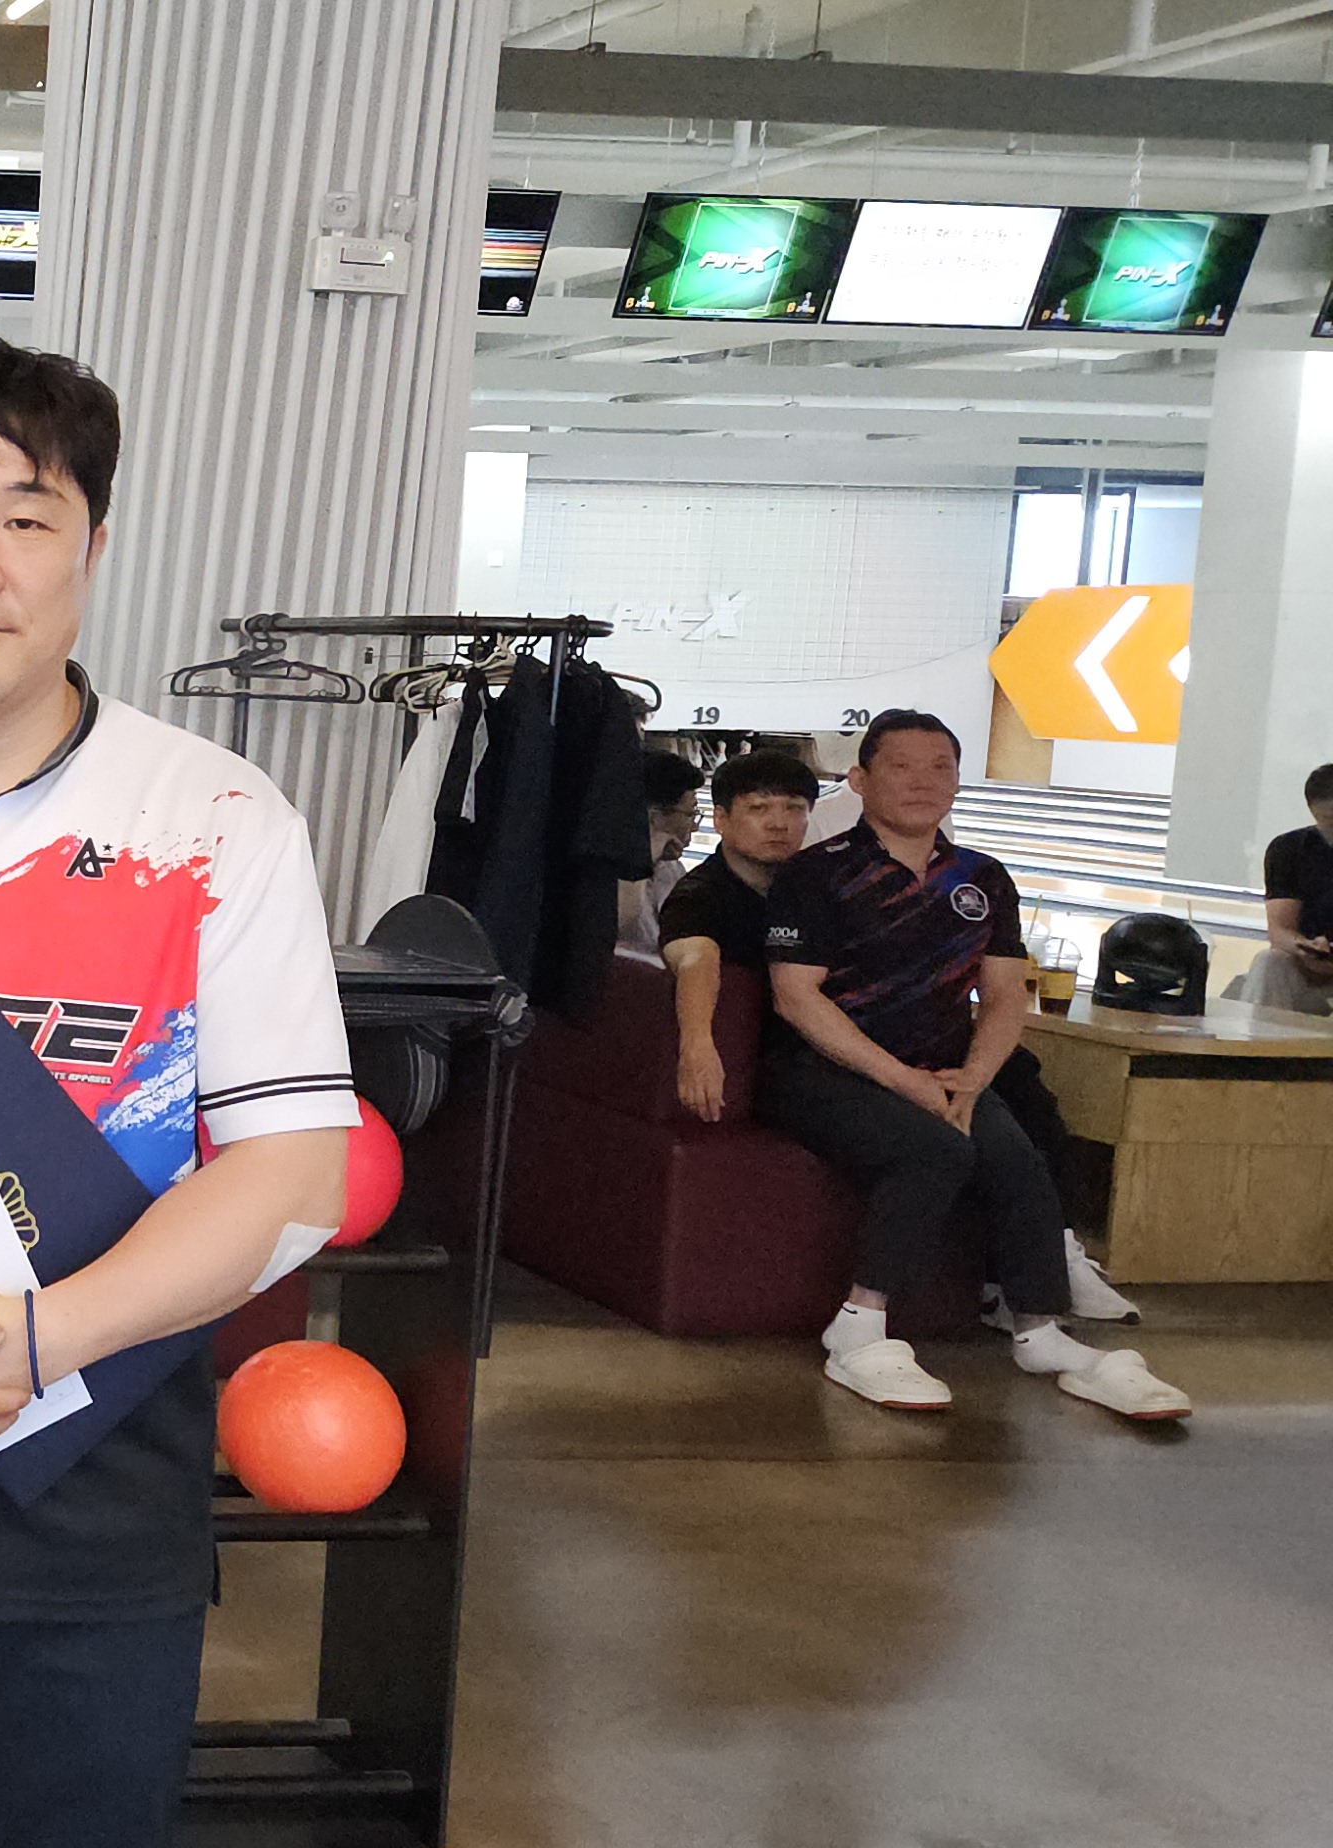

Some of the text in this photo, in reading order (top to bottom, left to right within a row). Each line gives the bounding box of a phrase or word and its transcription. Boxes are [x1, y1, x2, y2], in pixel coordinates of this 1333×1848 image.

[698, 246, 781, 275] PIN-X
[1113, 260, 1194, 288] PIN-X
[691, 706, 720, 726] 19
[841, 707, 871, 728] 20
